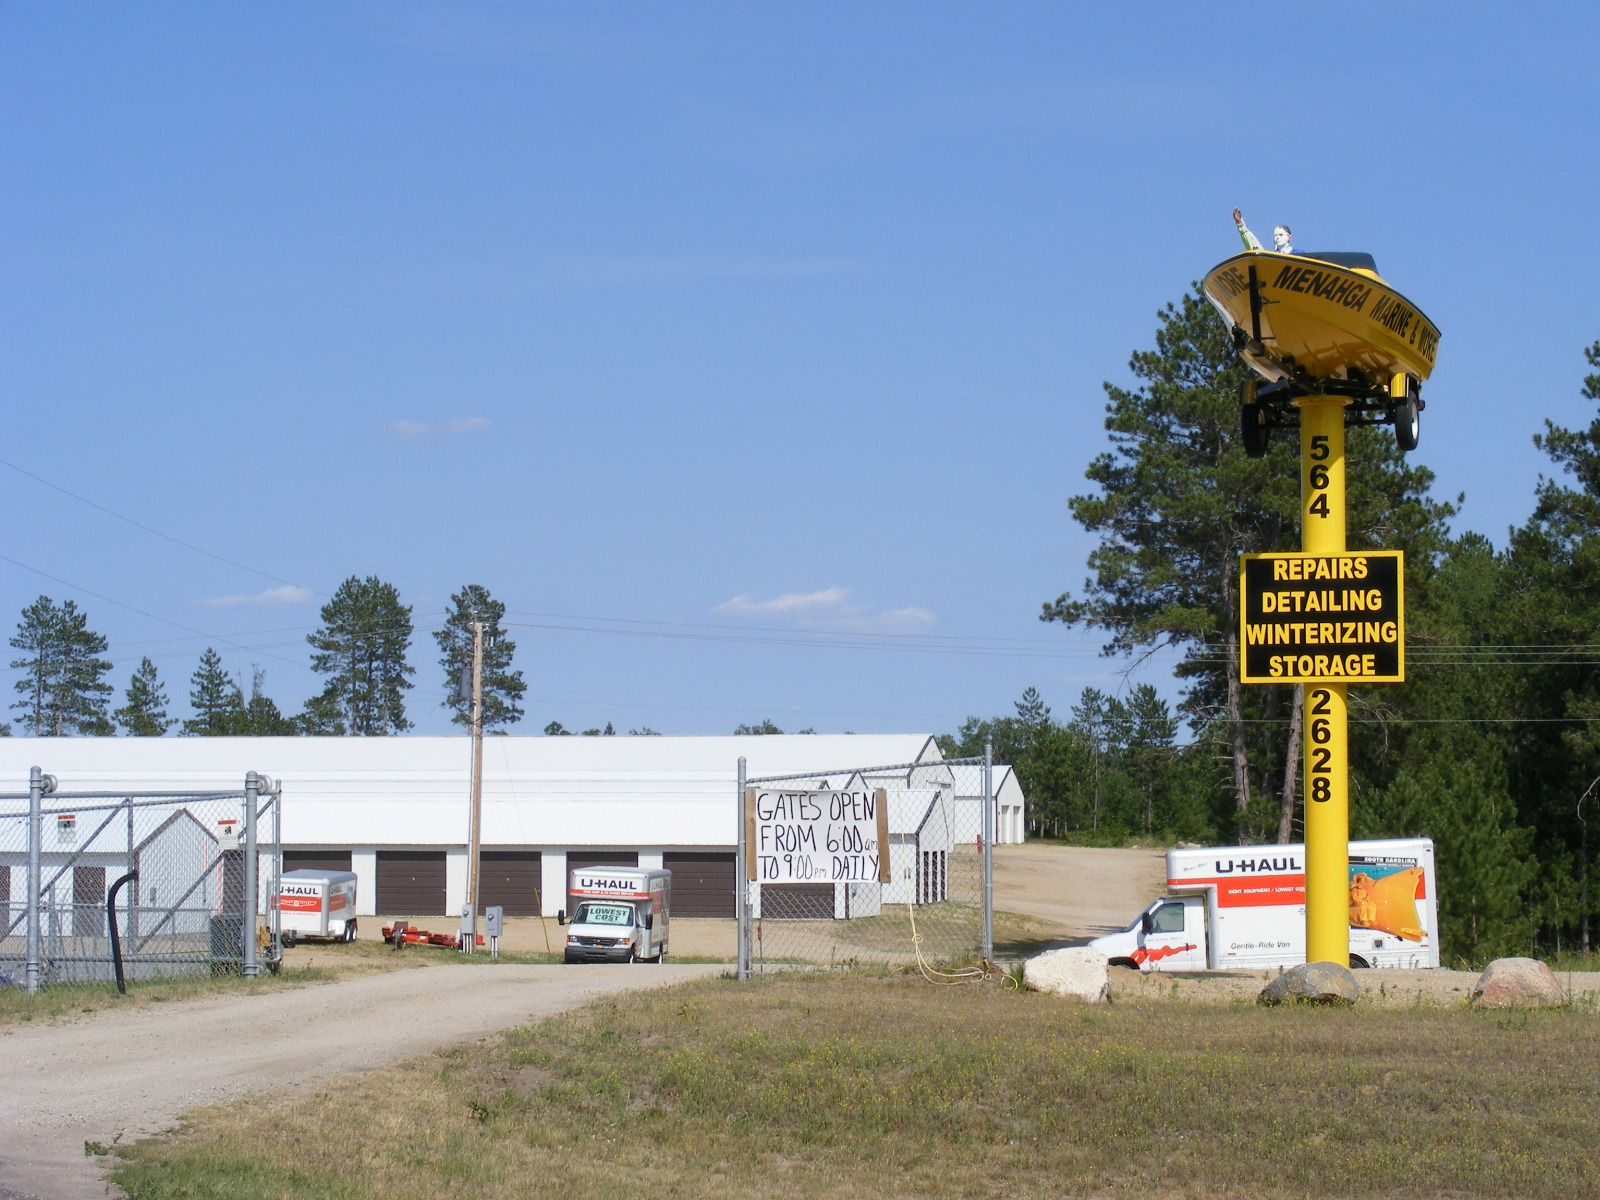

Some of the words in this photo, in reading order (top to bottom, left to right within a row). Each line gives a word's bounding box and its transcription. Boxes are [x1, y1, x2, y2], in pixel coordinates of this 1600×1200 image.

[1273, 265, 1372, 312] MENAHGA
[1369, 294, 1413, 338] MARINE
[1409, 319, 1420, 345] &
[1310, 435, 1330, 519] 564
[1273, 557, 1368, 581] REPAIRS
[1262, 589, 1382, 613] DETAILING
[1246, 621, 1397, 645] WINTERIZING
[1269, 654, 1376, 677] STORAGE
[1311, 689, 1332, 803] 2628
[757, 792, 822, 821] GATES
[830, 791, 875, 821] OPEN
[760, 824, 817, 852] FROM
[758, 855, 780, 880] TO
[832, 854, 879, 881] DAILY
[1215, 857, 1302, 874] U-HAUL
[581, 878, 637, 890] U-HAUL
[589, 907, 628, 917] LOWEST
[595, 914, 619, 922] COST
[1277, 940, 1291, 948] Van
